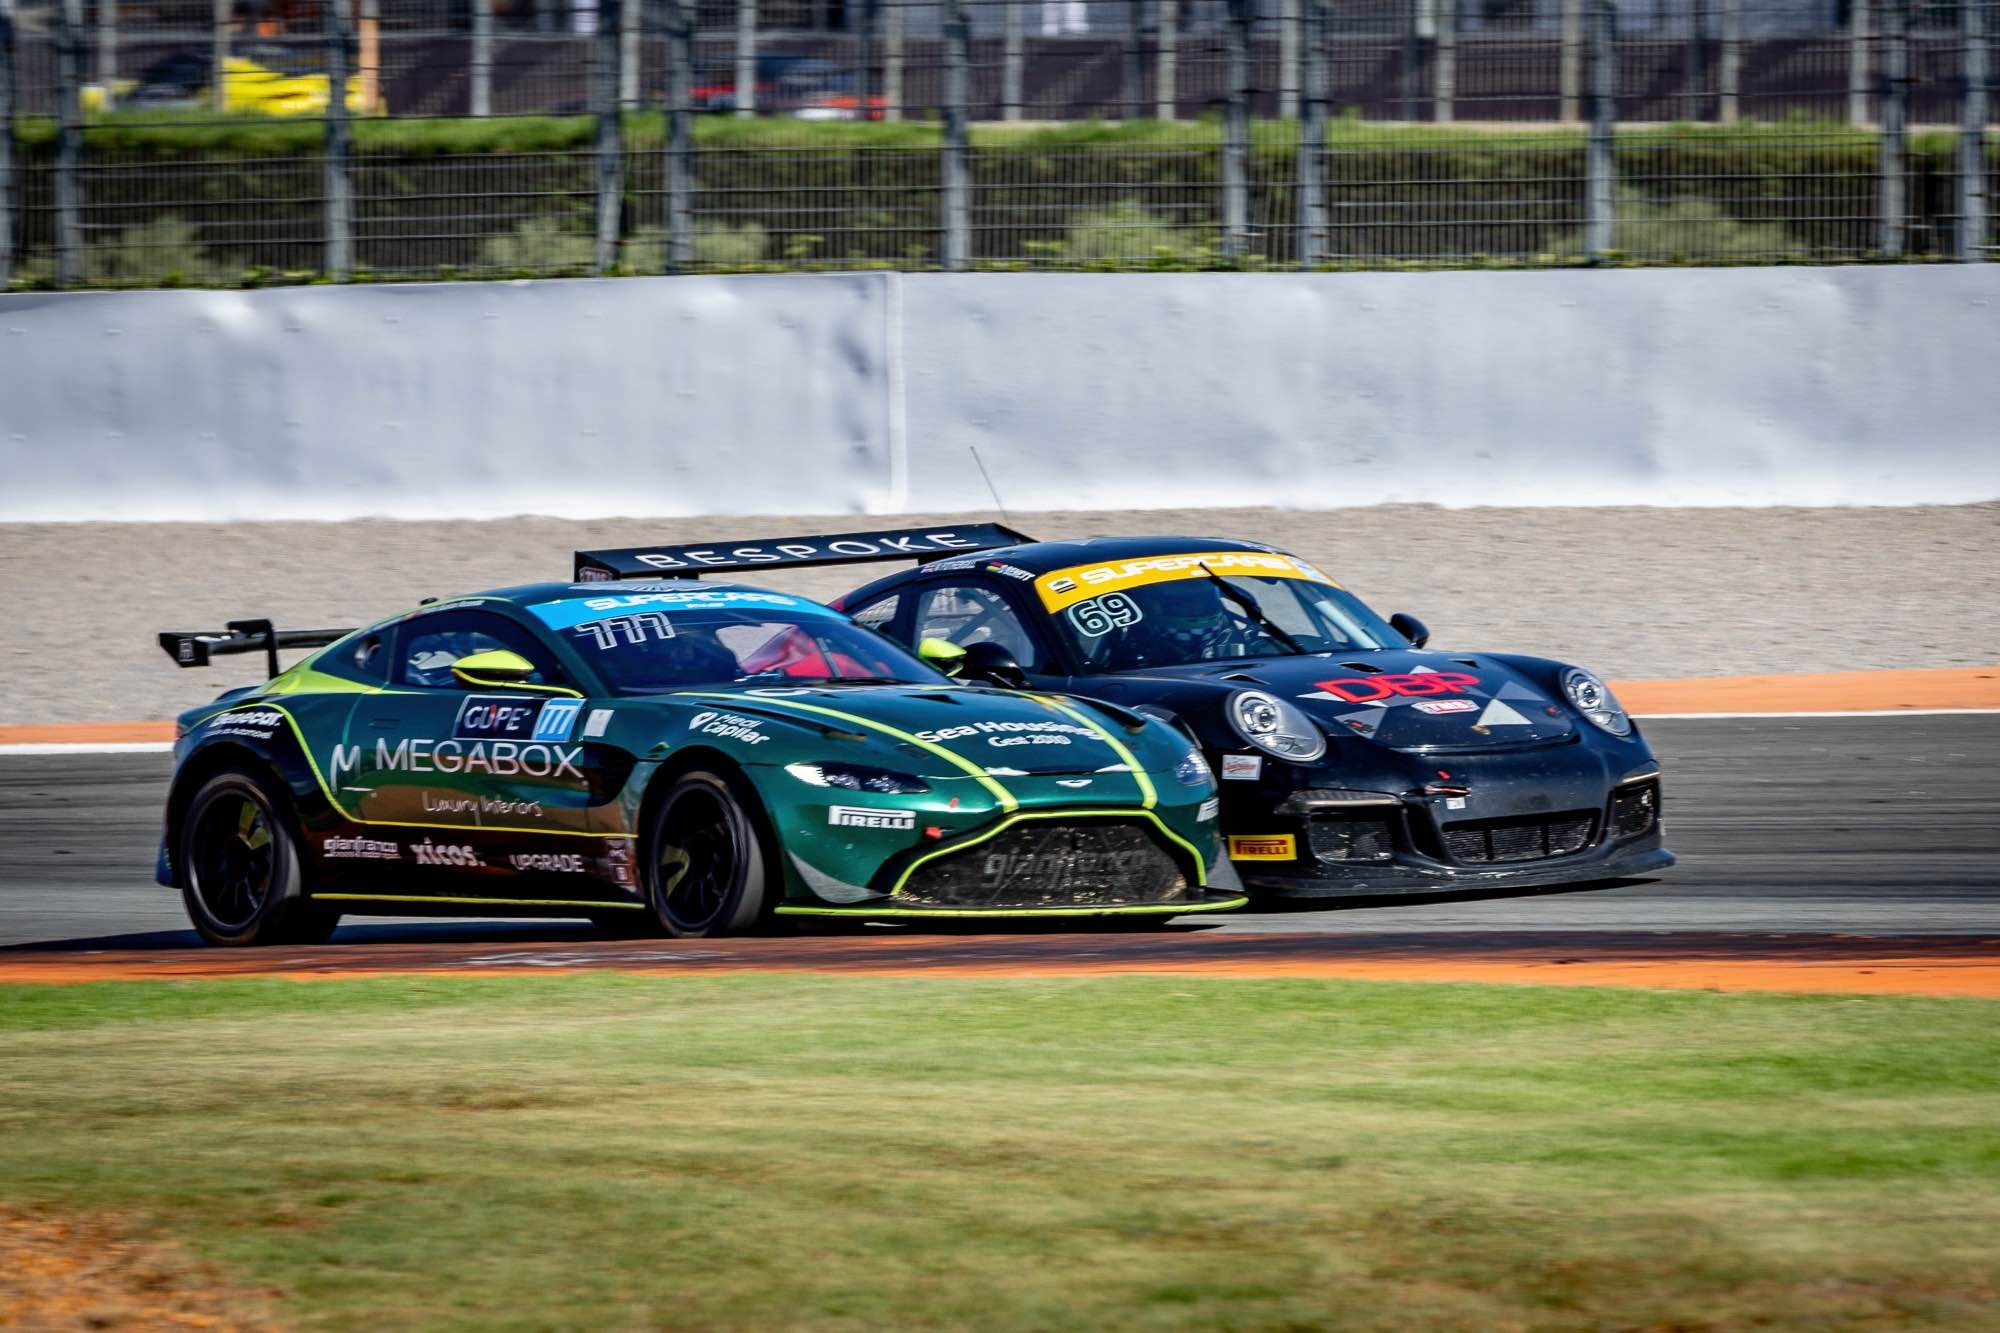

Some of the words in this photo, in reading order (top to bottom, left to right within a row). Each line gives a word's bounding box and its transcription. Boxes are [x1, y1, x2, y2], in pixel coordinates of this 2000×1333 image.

[635, 533, 980, 569] BESPOKE
[1079, 555, 1292, 585] SUPERCARS
[583, 591, 798, 611] SUPERCARS
[1068, 592, 1143, 637] 69
[574, 612, 676, 650] 777
[702, 722, 770, 745] Capilar
[915, 725, 979, 743] Sea
[376, 737, 585, 778] MEGABOX
[422, 792, 483, 826] Luxury
[480, 795, 543, 817] Interiors
[828, 805, 916, 829] PIRELLI
[1234, 839, 1289, 854] PIRELLI
[508, 853, 585, 872] UPGRADE
